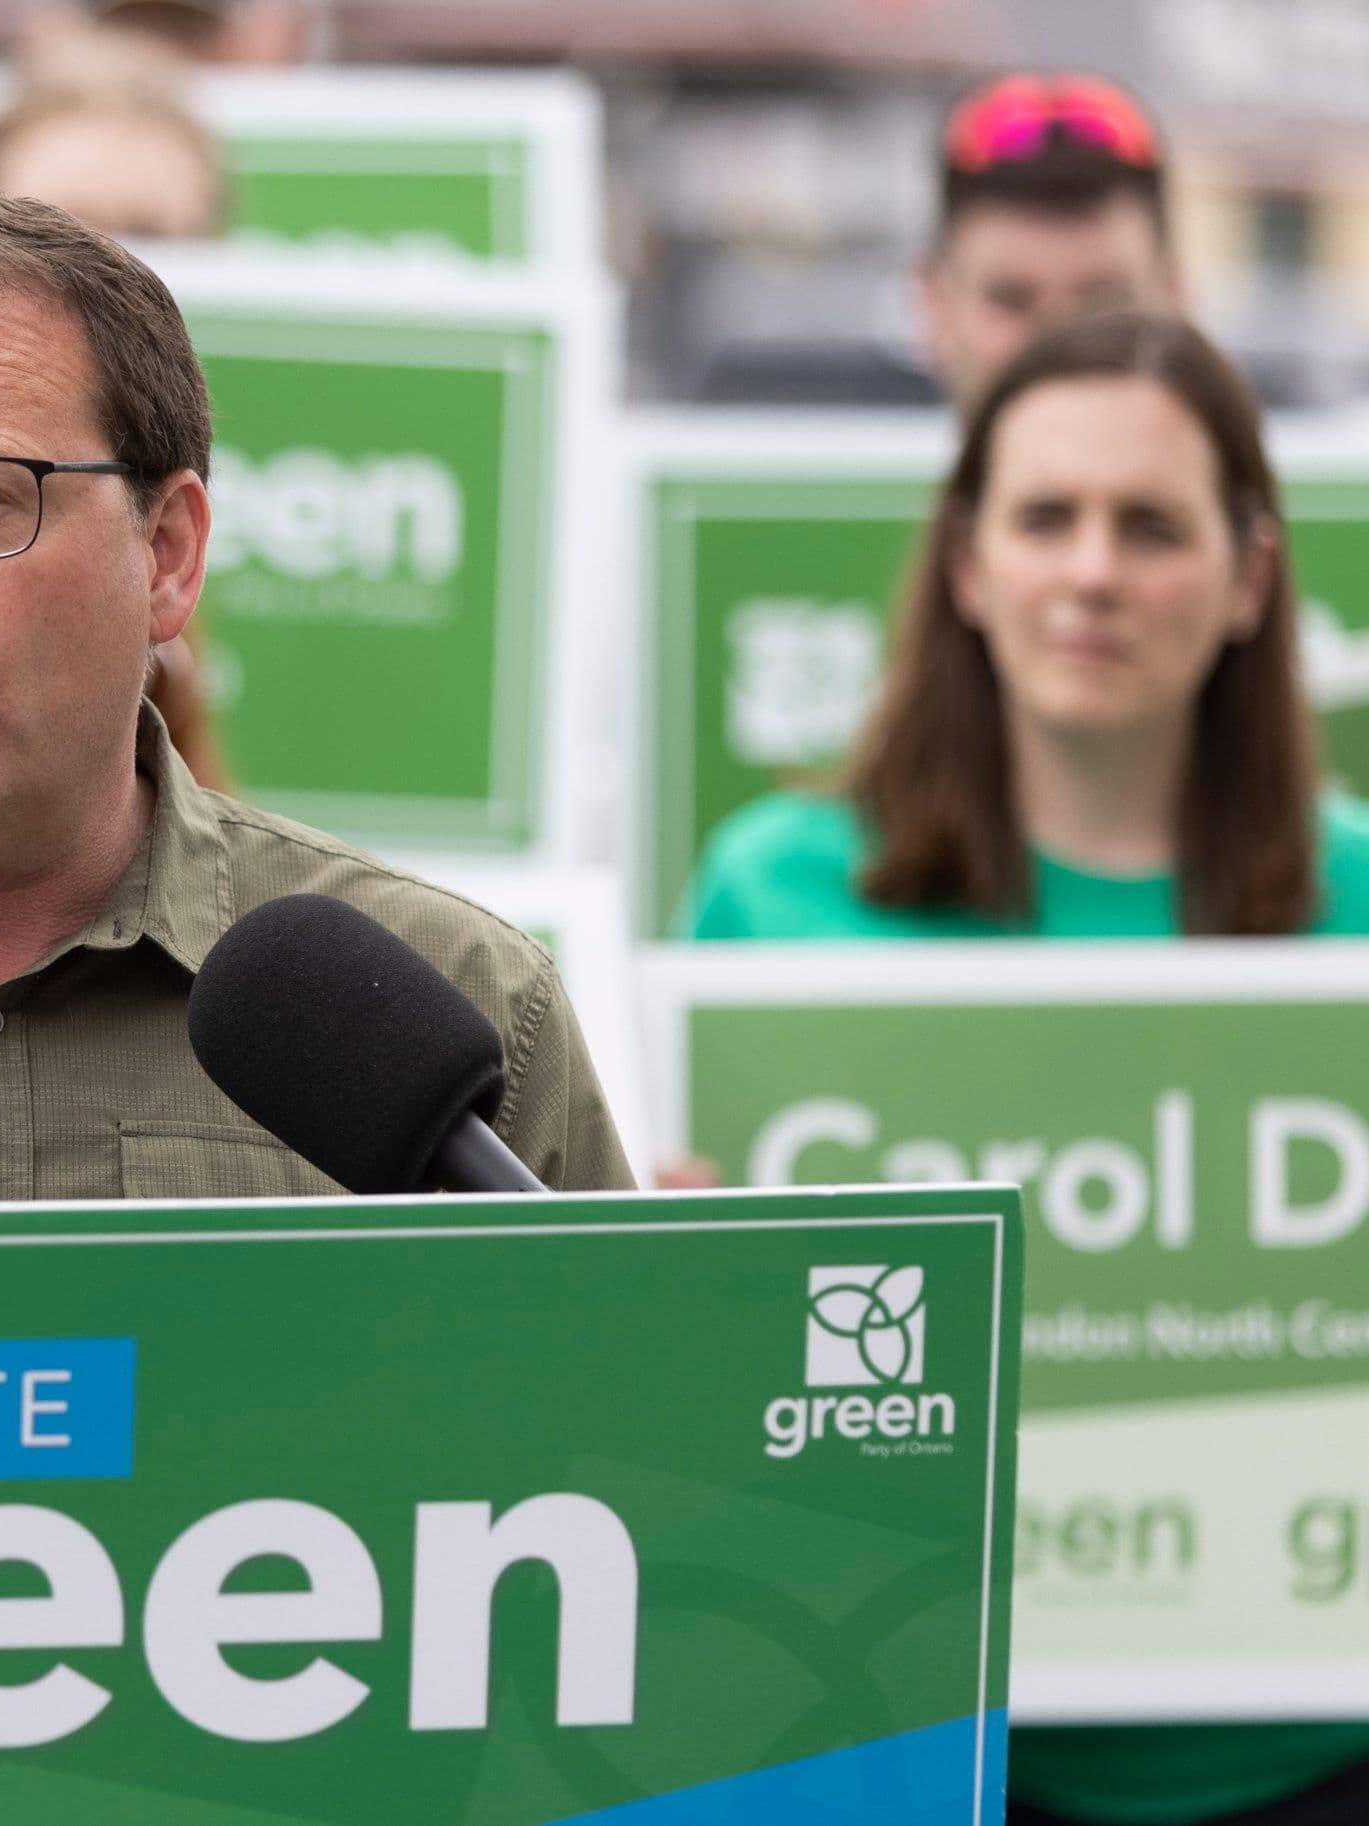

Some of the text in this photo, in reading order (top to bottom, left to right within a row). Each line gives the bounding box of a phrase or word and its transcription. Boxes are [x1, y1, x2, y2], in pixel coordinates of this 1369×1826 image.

[763, 1392, 955, 1458] green
[861, 1440, 954, 1459] Party of Ontario
